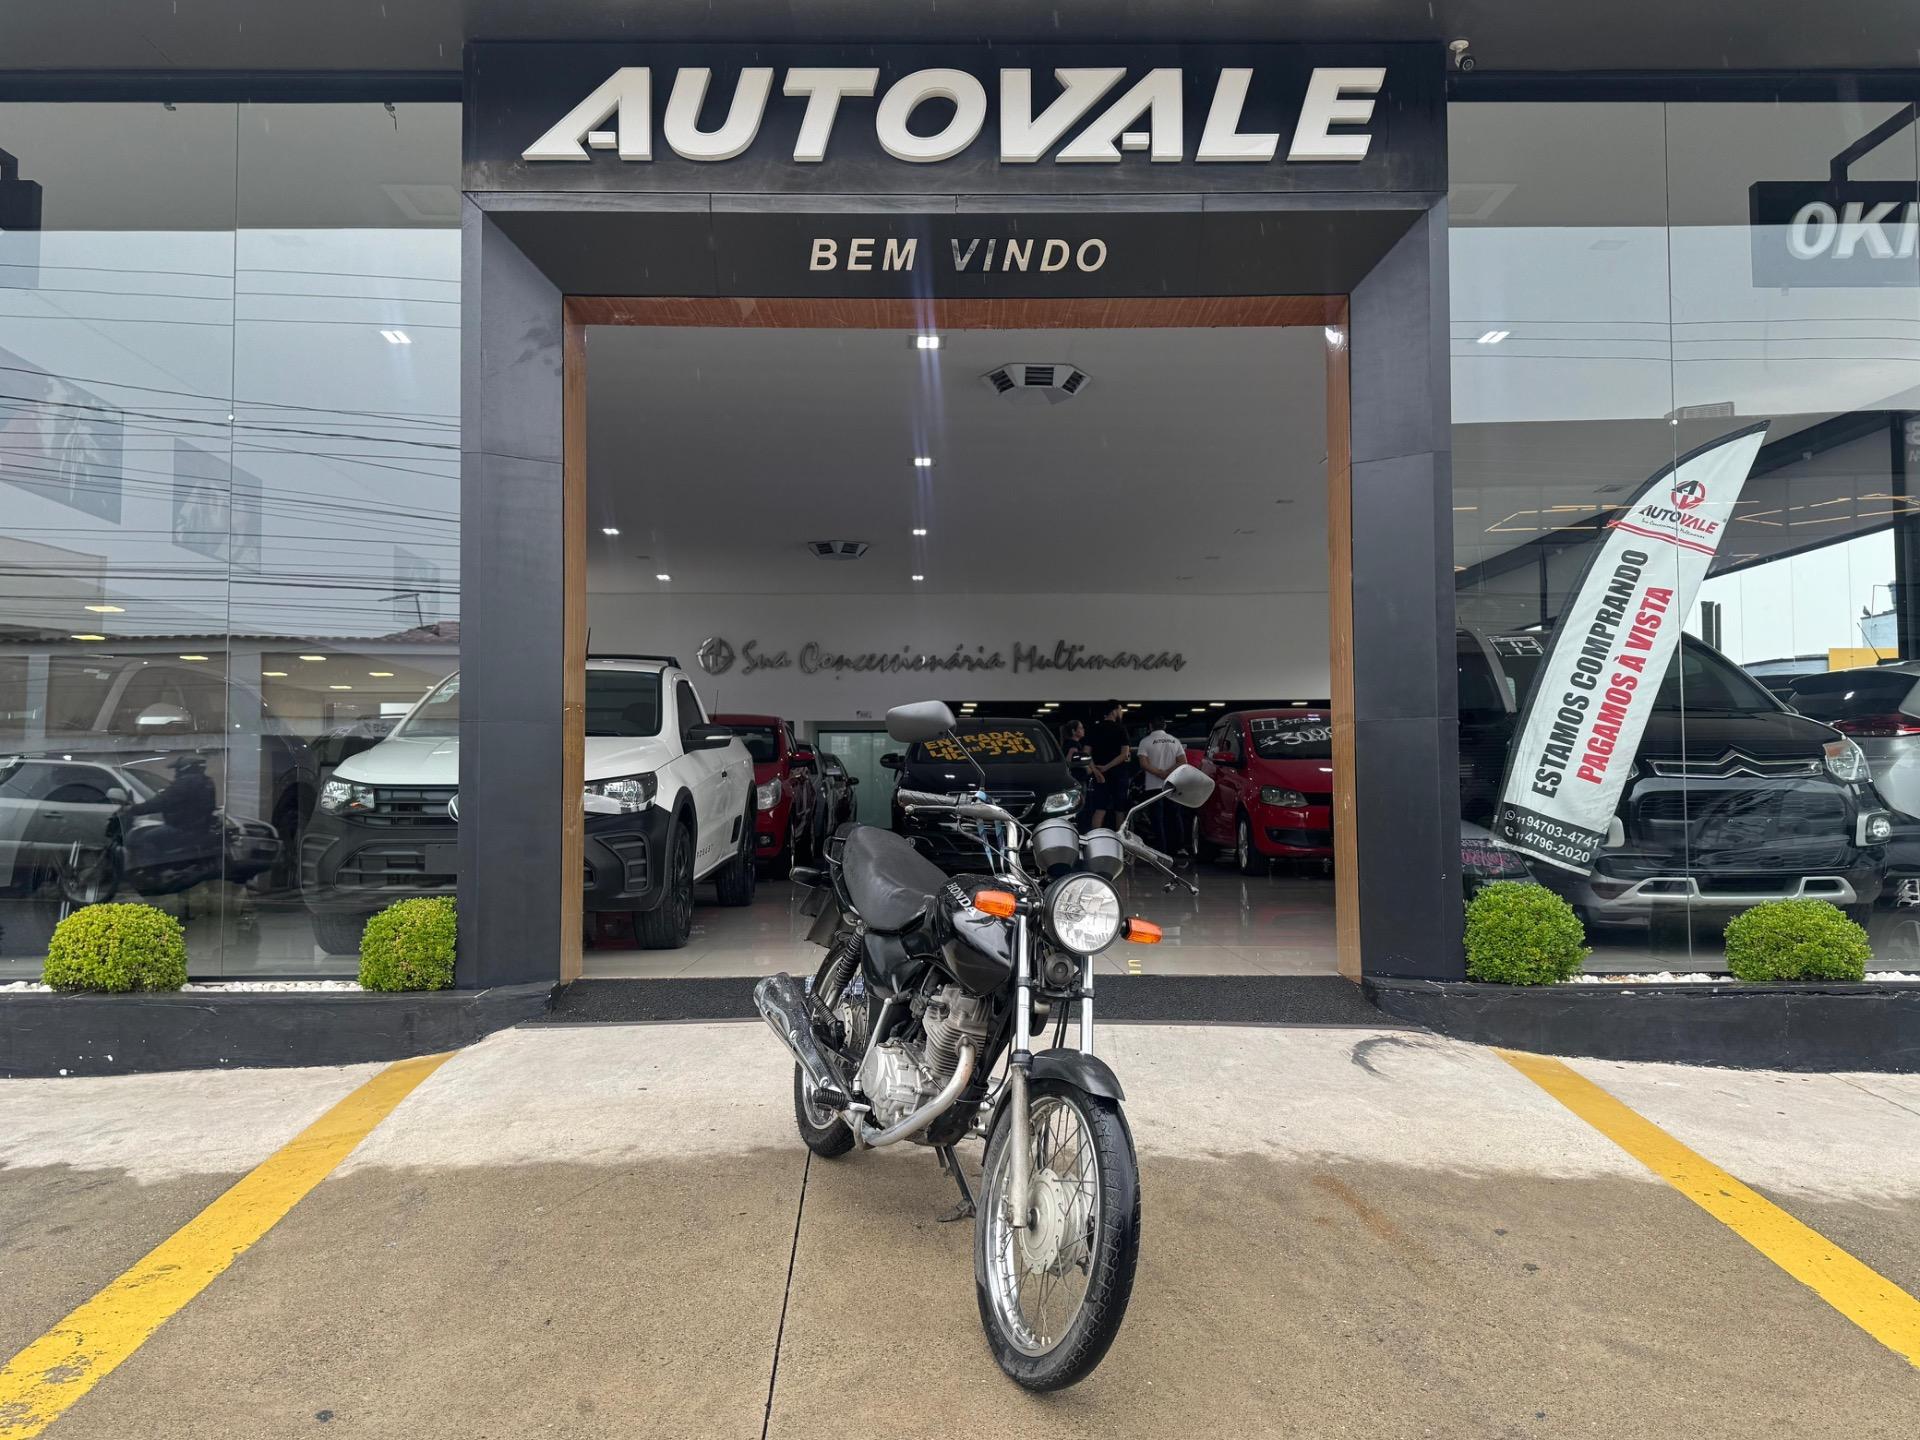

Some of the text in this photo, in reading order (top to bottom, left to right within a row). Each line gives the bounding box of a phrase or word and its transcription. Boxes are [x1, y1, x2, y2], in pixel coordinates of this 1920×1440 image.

[521, 66, 1387, 163] AUTOVALE
[809, 238, 1107, 272] BEM VINDO
[1639, 504, 1719, 535] AUTOVALE
[1624, 586, 1674, 651] VISTA
[741, 640, 793, 674] Sua
[1012, 639, 1187, 674] Multimarcas
[1531, 549, 1649, 798] ESTAMOS COMPRANDO
[1613, 654, 1647, 673] À
[1576, 672, 1638, 785] PAGAMOS
[1524, 832, 1591, 863] 4796-2020
[1526, 815, 1600, 849] 94703-4741
[946, 882, 978, 918] HONDA
